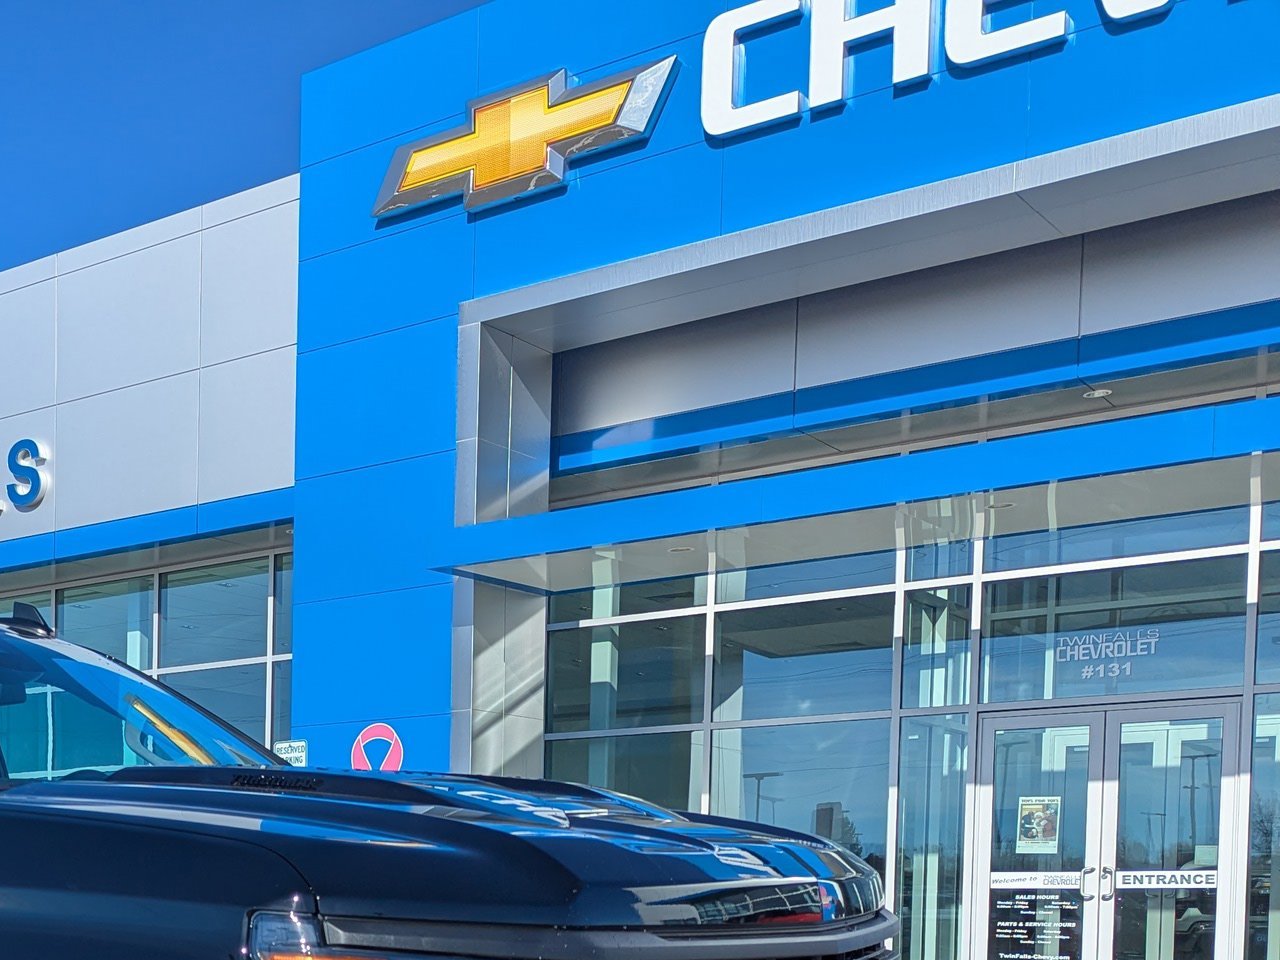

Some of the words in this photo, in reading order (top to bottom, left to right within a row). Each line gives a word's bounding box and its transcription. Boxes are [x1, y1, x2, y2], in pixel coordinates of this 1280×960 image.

[1056, 629, 1159, 647] TWINFALLS
[1056, 638, 1160, 662] CHEVROLET
[1081, 661, 1132, 679] #131
[276, 744, 305, 755] RESERVED
[282, 755, 304, 764] RKING
[1121, 874, 1215, 885] ENTRANCE
[999, 953, 1071, 960] TwinFalls-Chevy.com
